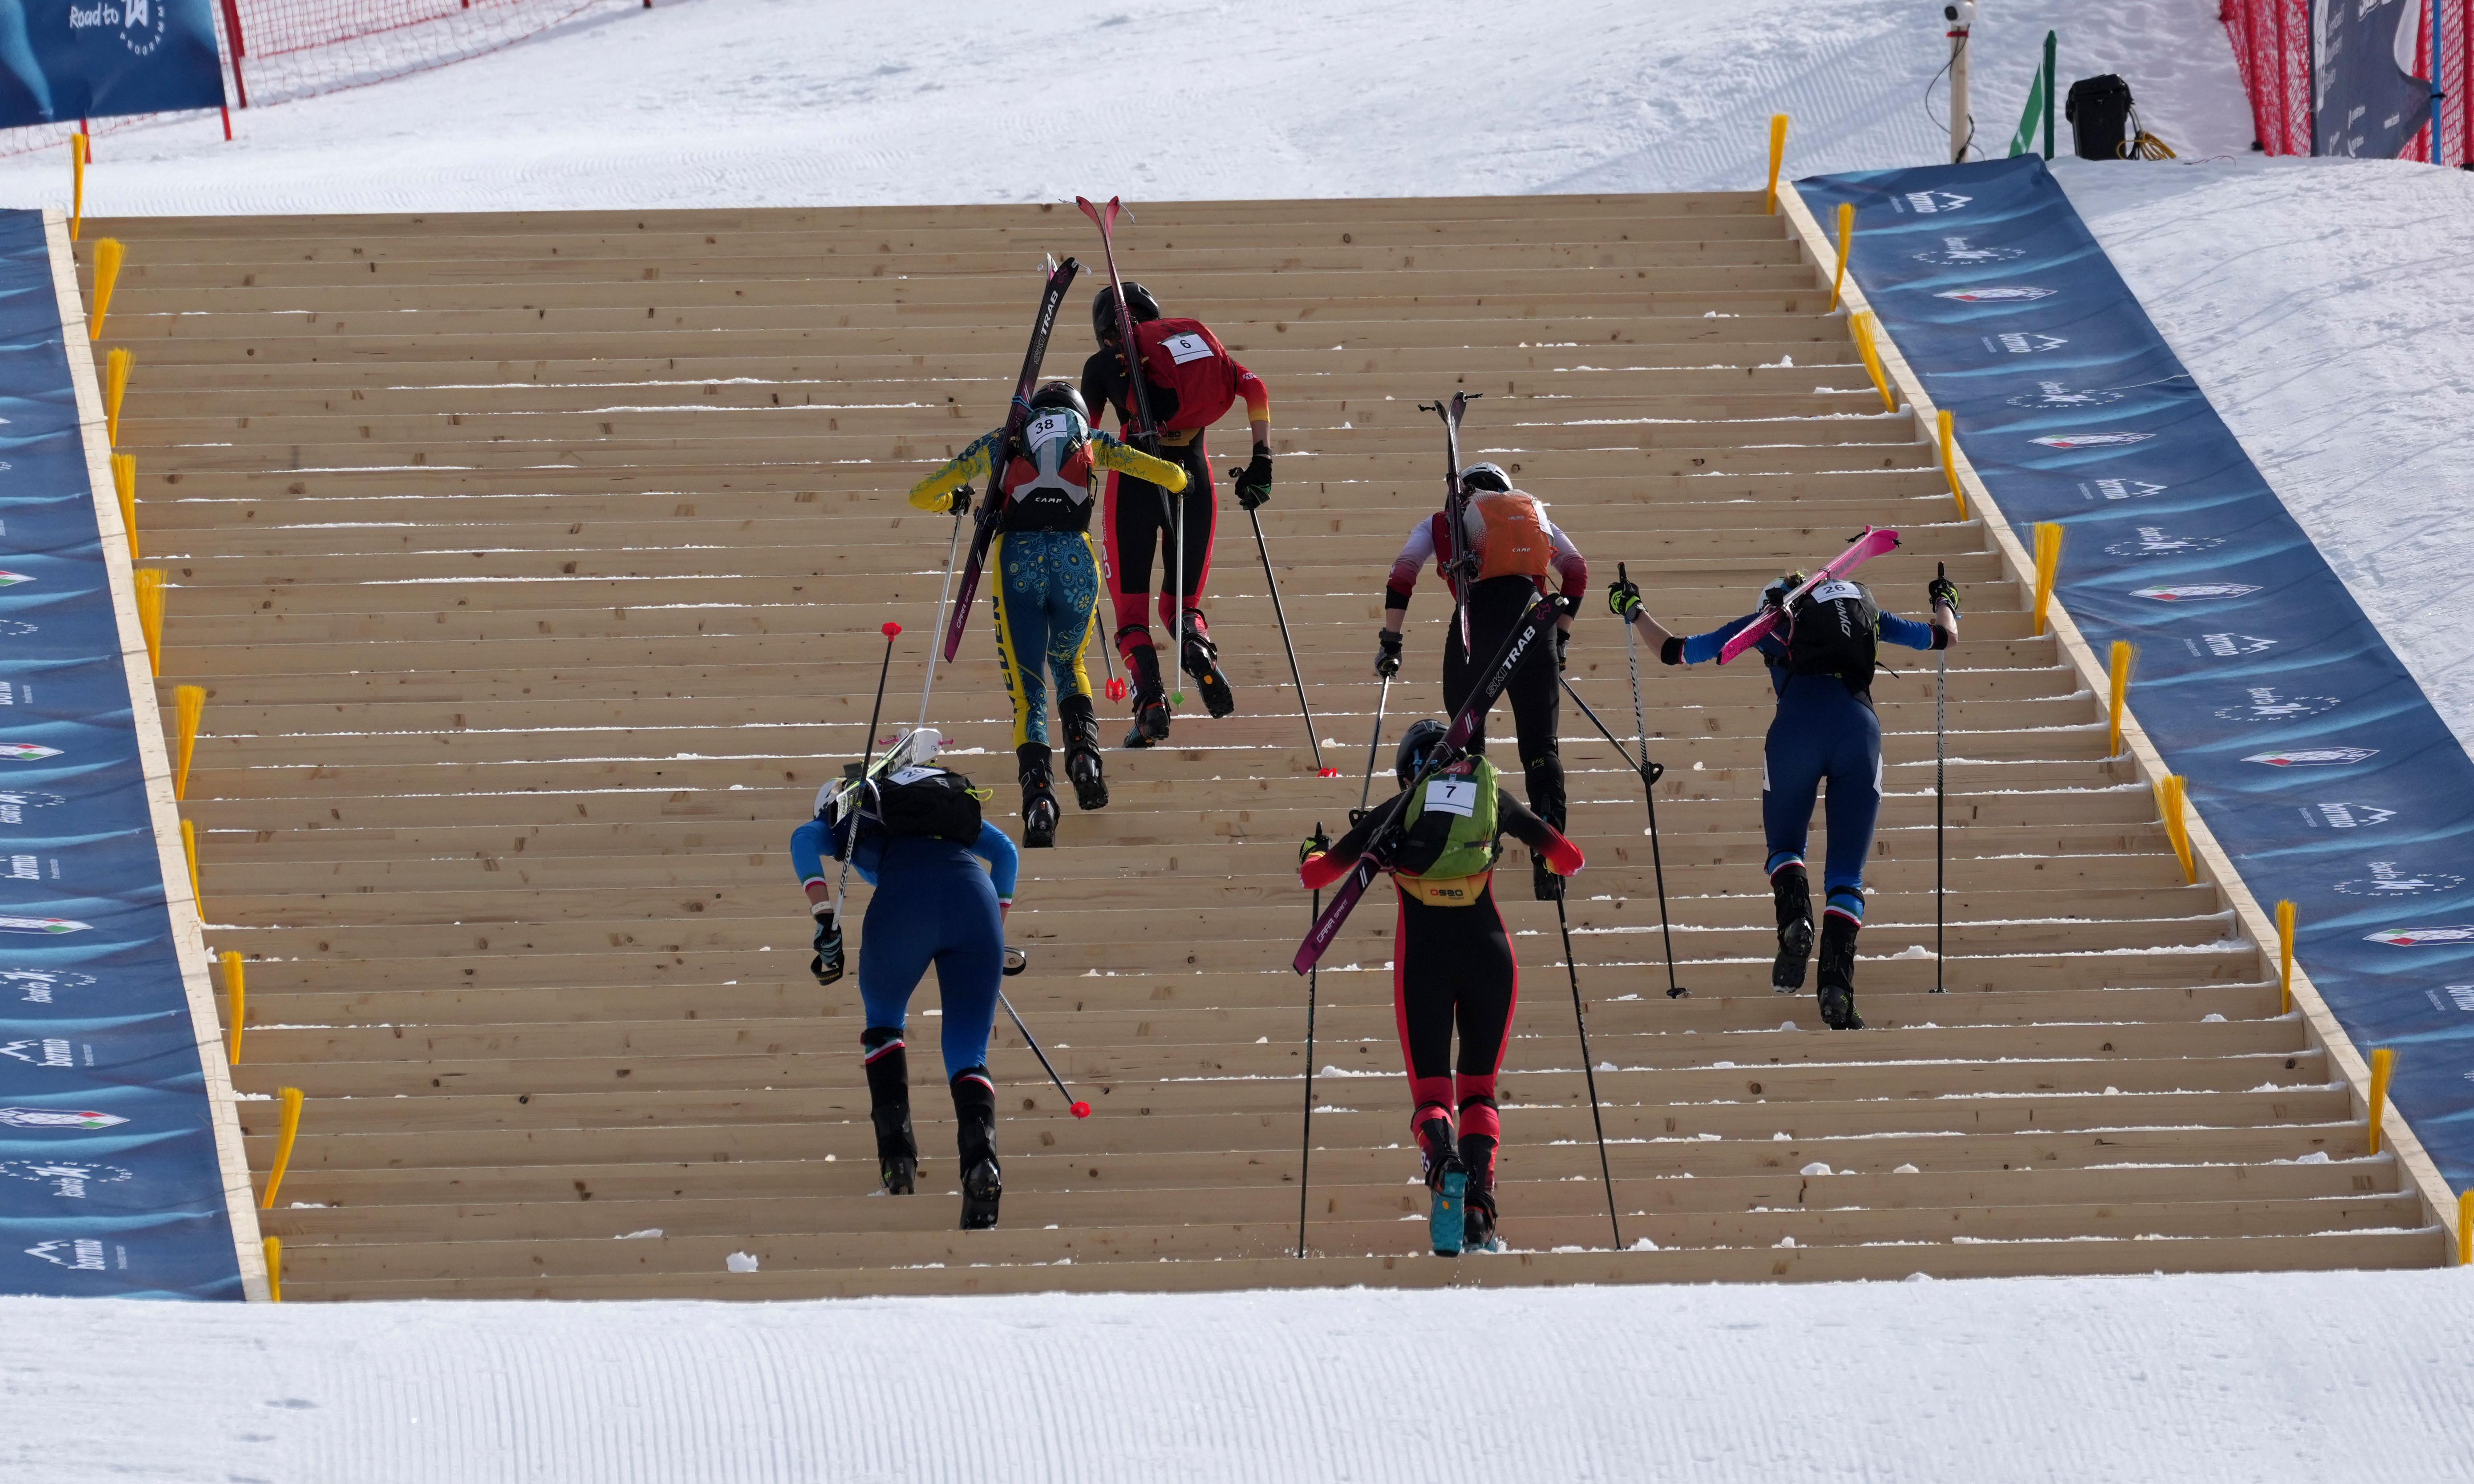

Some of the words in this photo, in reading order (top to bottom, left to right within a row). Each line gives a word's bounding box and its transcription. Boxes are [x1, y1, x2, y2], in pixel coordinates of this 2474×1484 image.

[69, 2, 101, 29] Road
[102, 3, 119, 25] to
[119, 0, 165, 56] PROGRAMM
[1180, 340, 1192, 349] 6
[1035, 419, 1054, 434] 38
[2095, 479, 2141, 499] bormio
[1823, 584, 1846, 594] 26
[956, 603, 967, 629] GARA
[2202, 633, 2251, 656] bormio
[992, 595, 1018, 730] EDEN
[1485, 625, 1536, 698] SKITRAB
[902, 768, 925, 778] 20
[1446, 785, 1457, 799] 7
[2317, 802, 2369, 828] bormio
[4, 855, 40, 880] bormio
[1316, 918, 1335, 943] GARA
[28, 1039, 73, 1067] bormio
[58, 1238, 106, 1270] bormio
